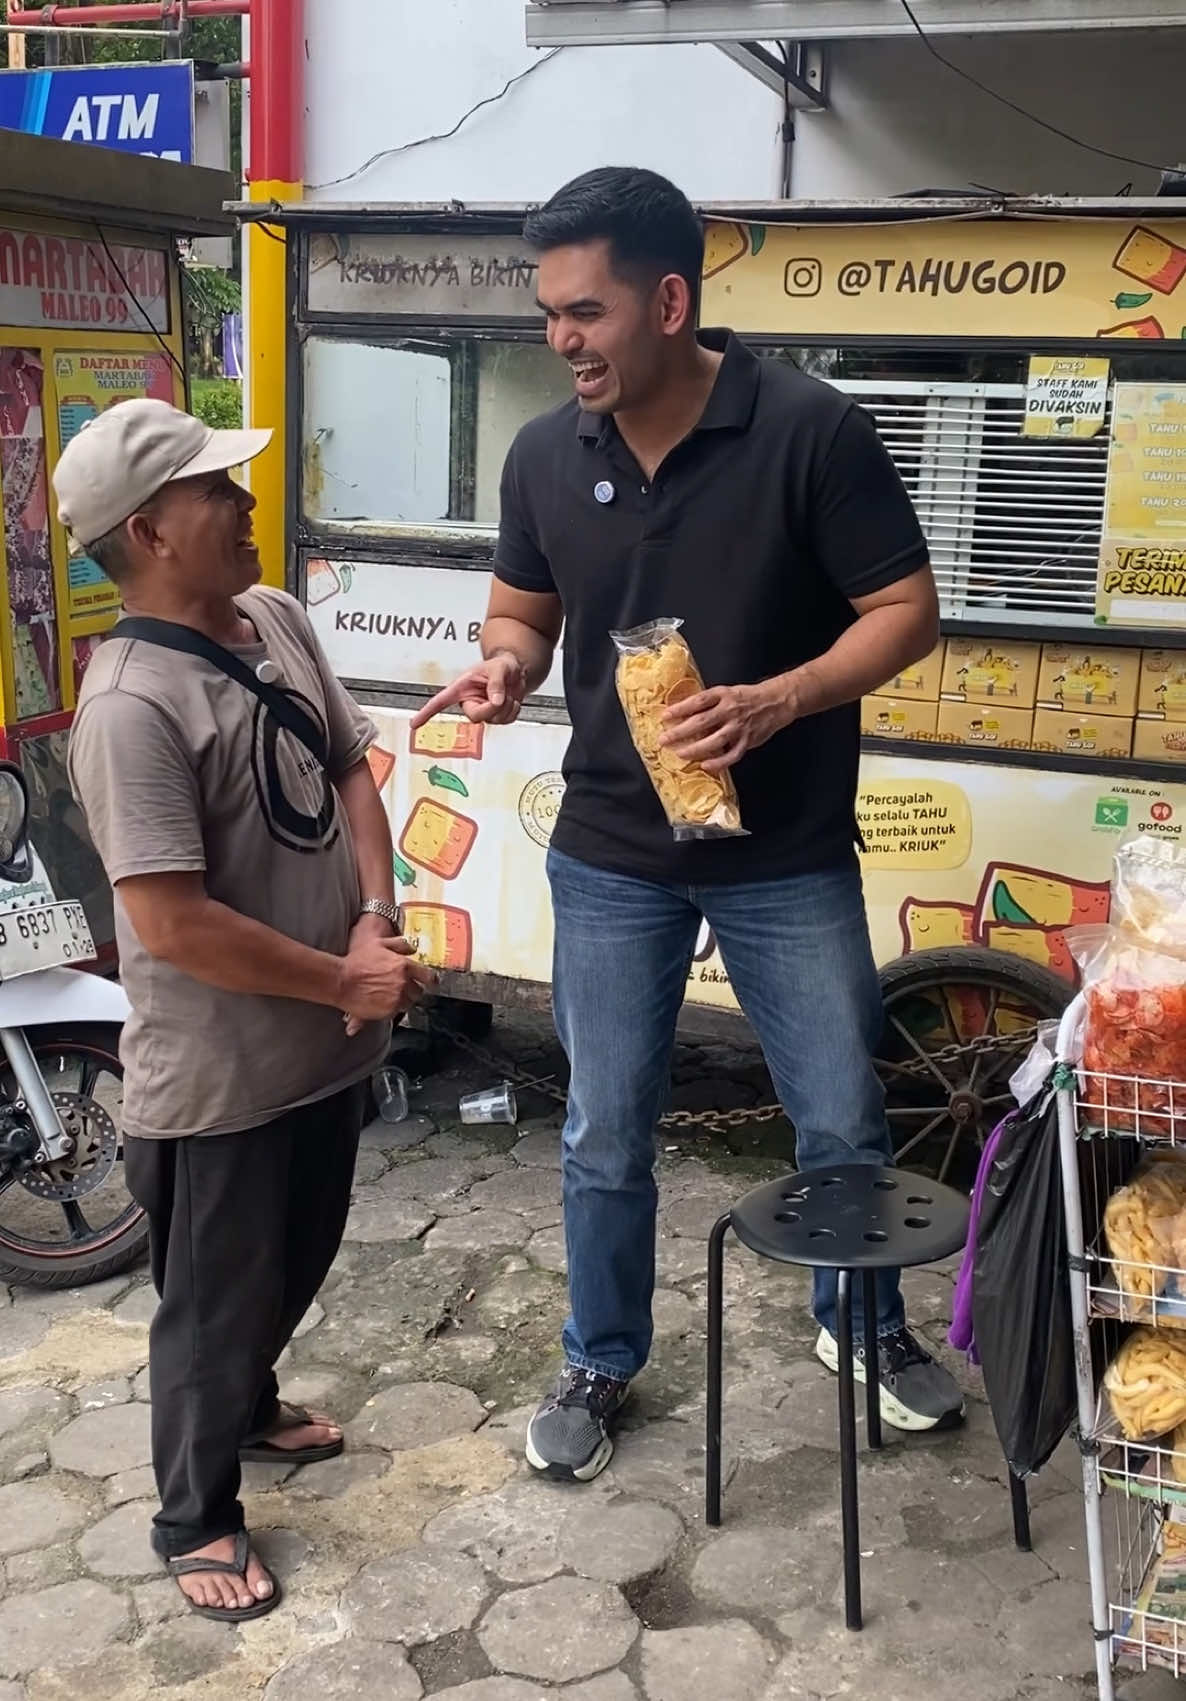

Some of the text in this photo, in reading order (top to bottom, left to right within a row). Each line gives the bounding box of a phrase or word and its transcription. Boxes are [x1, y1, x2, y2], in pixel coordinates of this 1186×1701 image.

[62, 94, 159, 141] ATM
[838, 258, 1066, 296] @TAHUGOID
[41, 291, 129, 324] MALEO 99
[80, 358, 129, 369] DAFTAR
[1037, 378, 1098, 389] STAFF KAMI
[1049, 389, 1084, 398] SUDAH
[1029, 400, 1102, 414] DIVAKSIN
[1104, 571, 1186, 596] PESAN
[335, 610, 482, 643] KRIUKNYA B
[857, 807, 948, 821] ku selalu TAHU
[876, 825, 918, 837] terbaik
[921, 824, 956, 835] untuk
[1138, 823, 1182, 832] gofood
[17, 908, 58, 938] 6837
